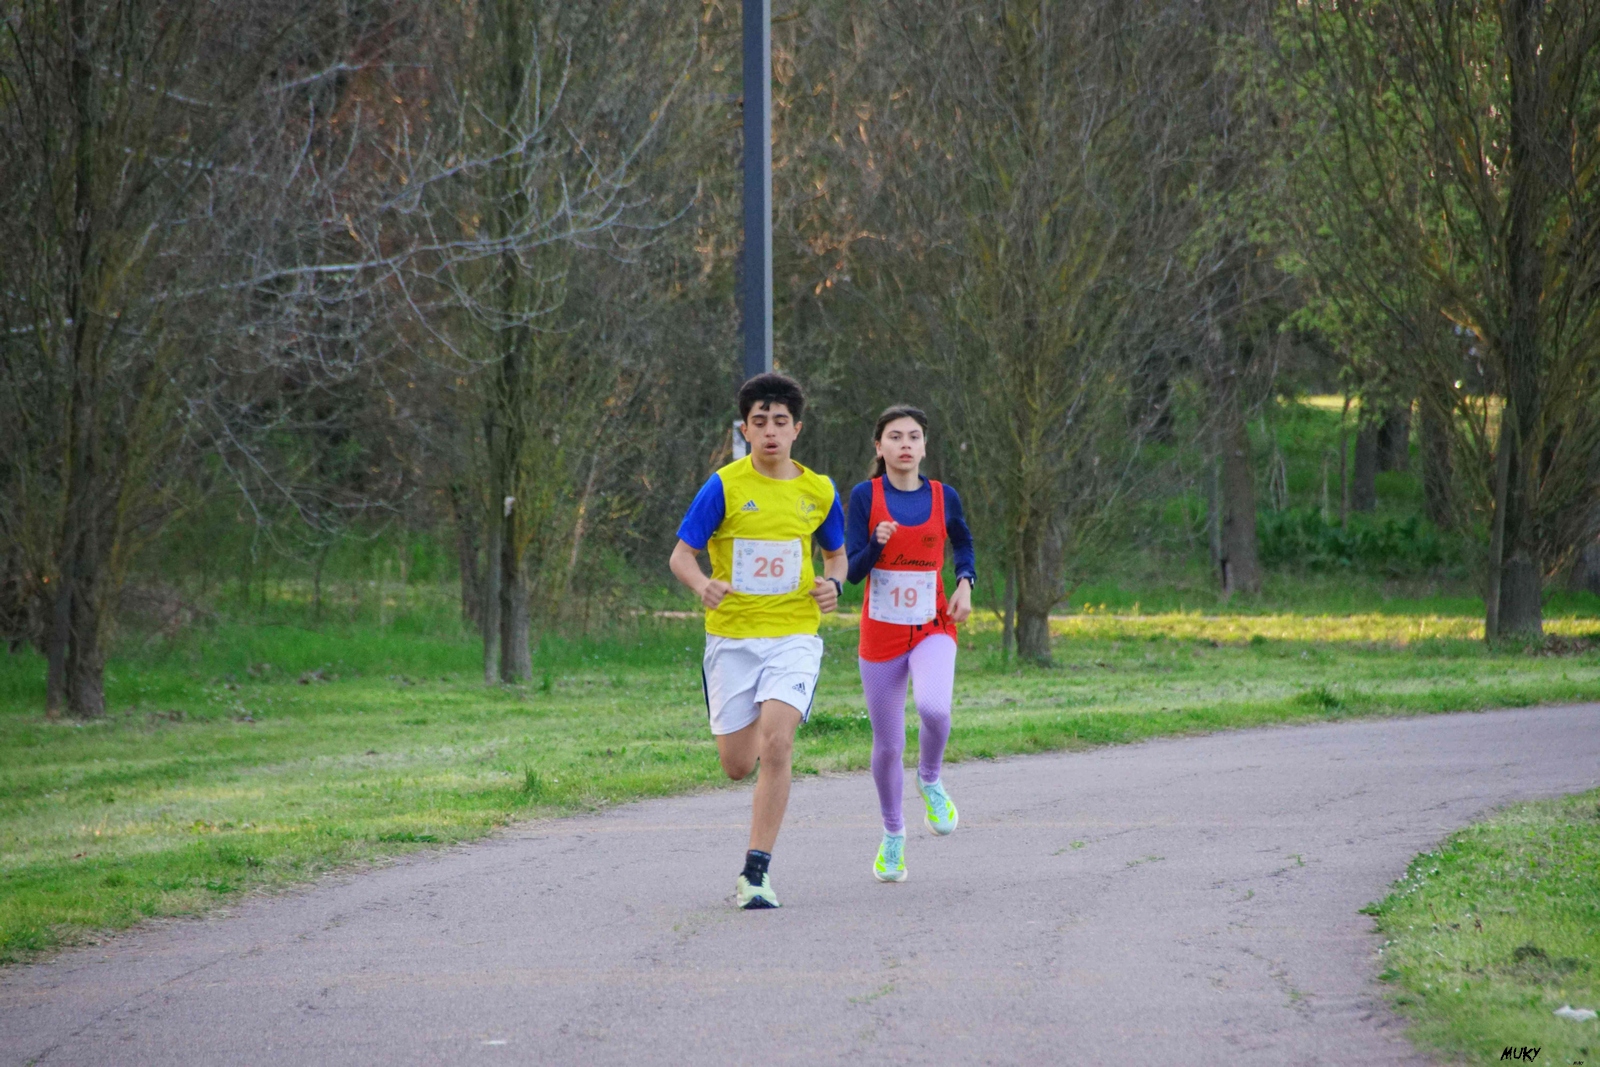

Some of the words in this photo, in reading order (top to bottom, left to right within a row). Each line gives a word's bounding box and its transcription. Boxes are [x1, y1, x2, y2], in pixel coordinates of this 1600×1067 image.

[753, 556, 785, 578] 26
[890, 553, 937, 568] Lamone
[890, 587, 918, 608] 19
